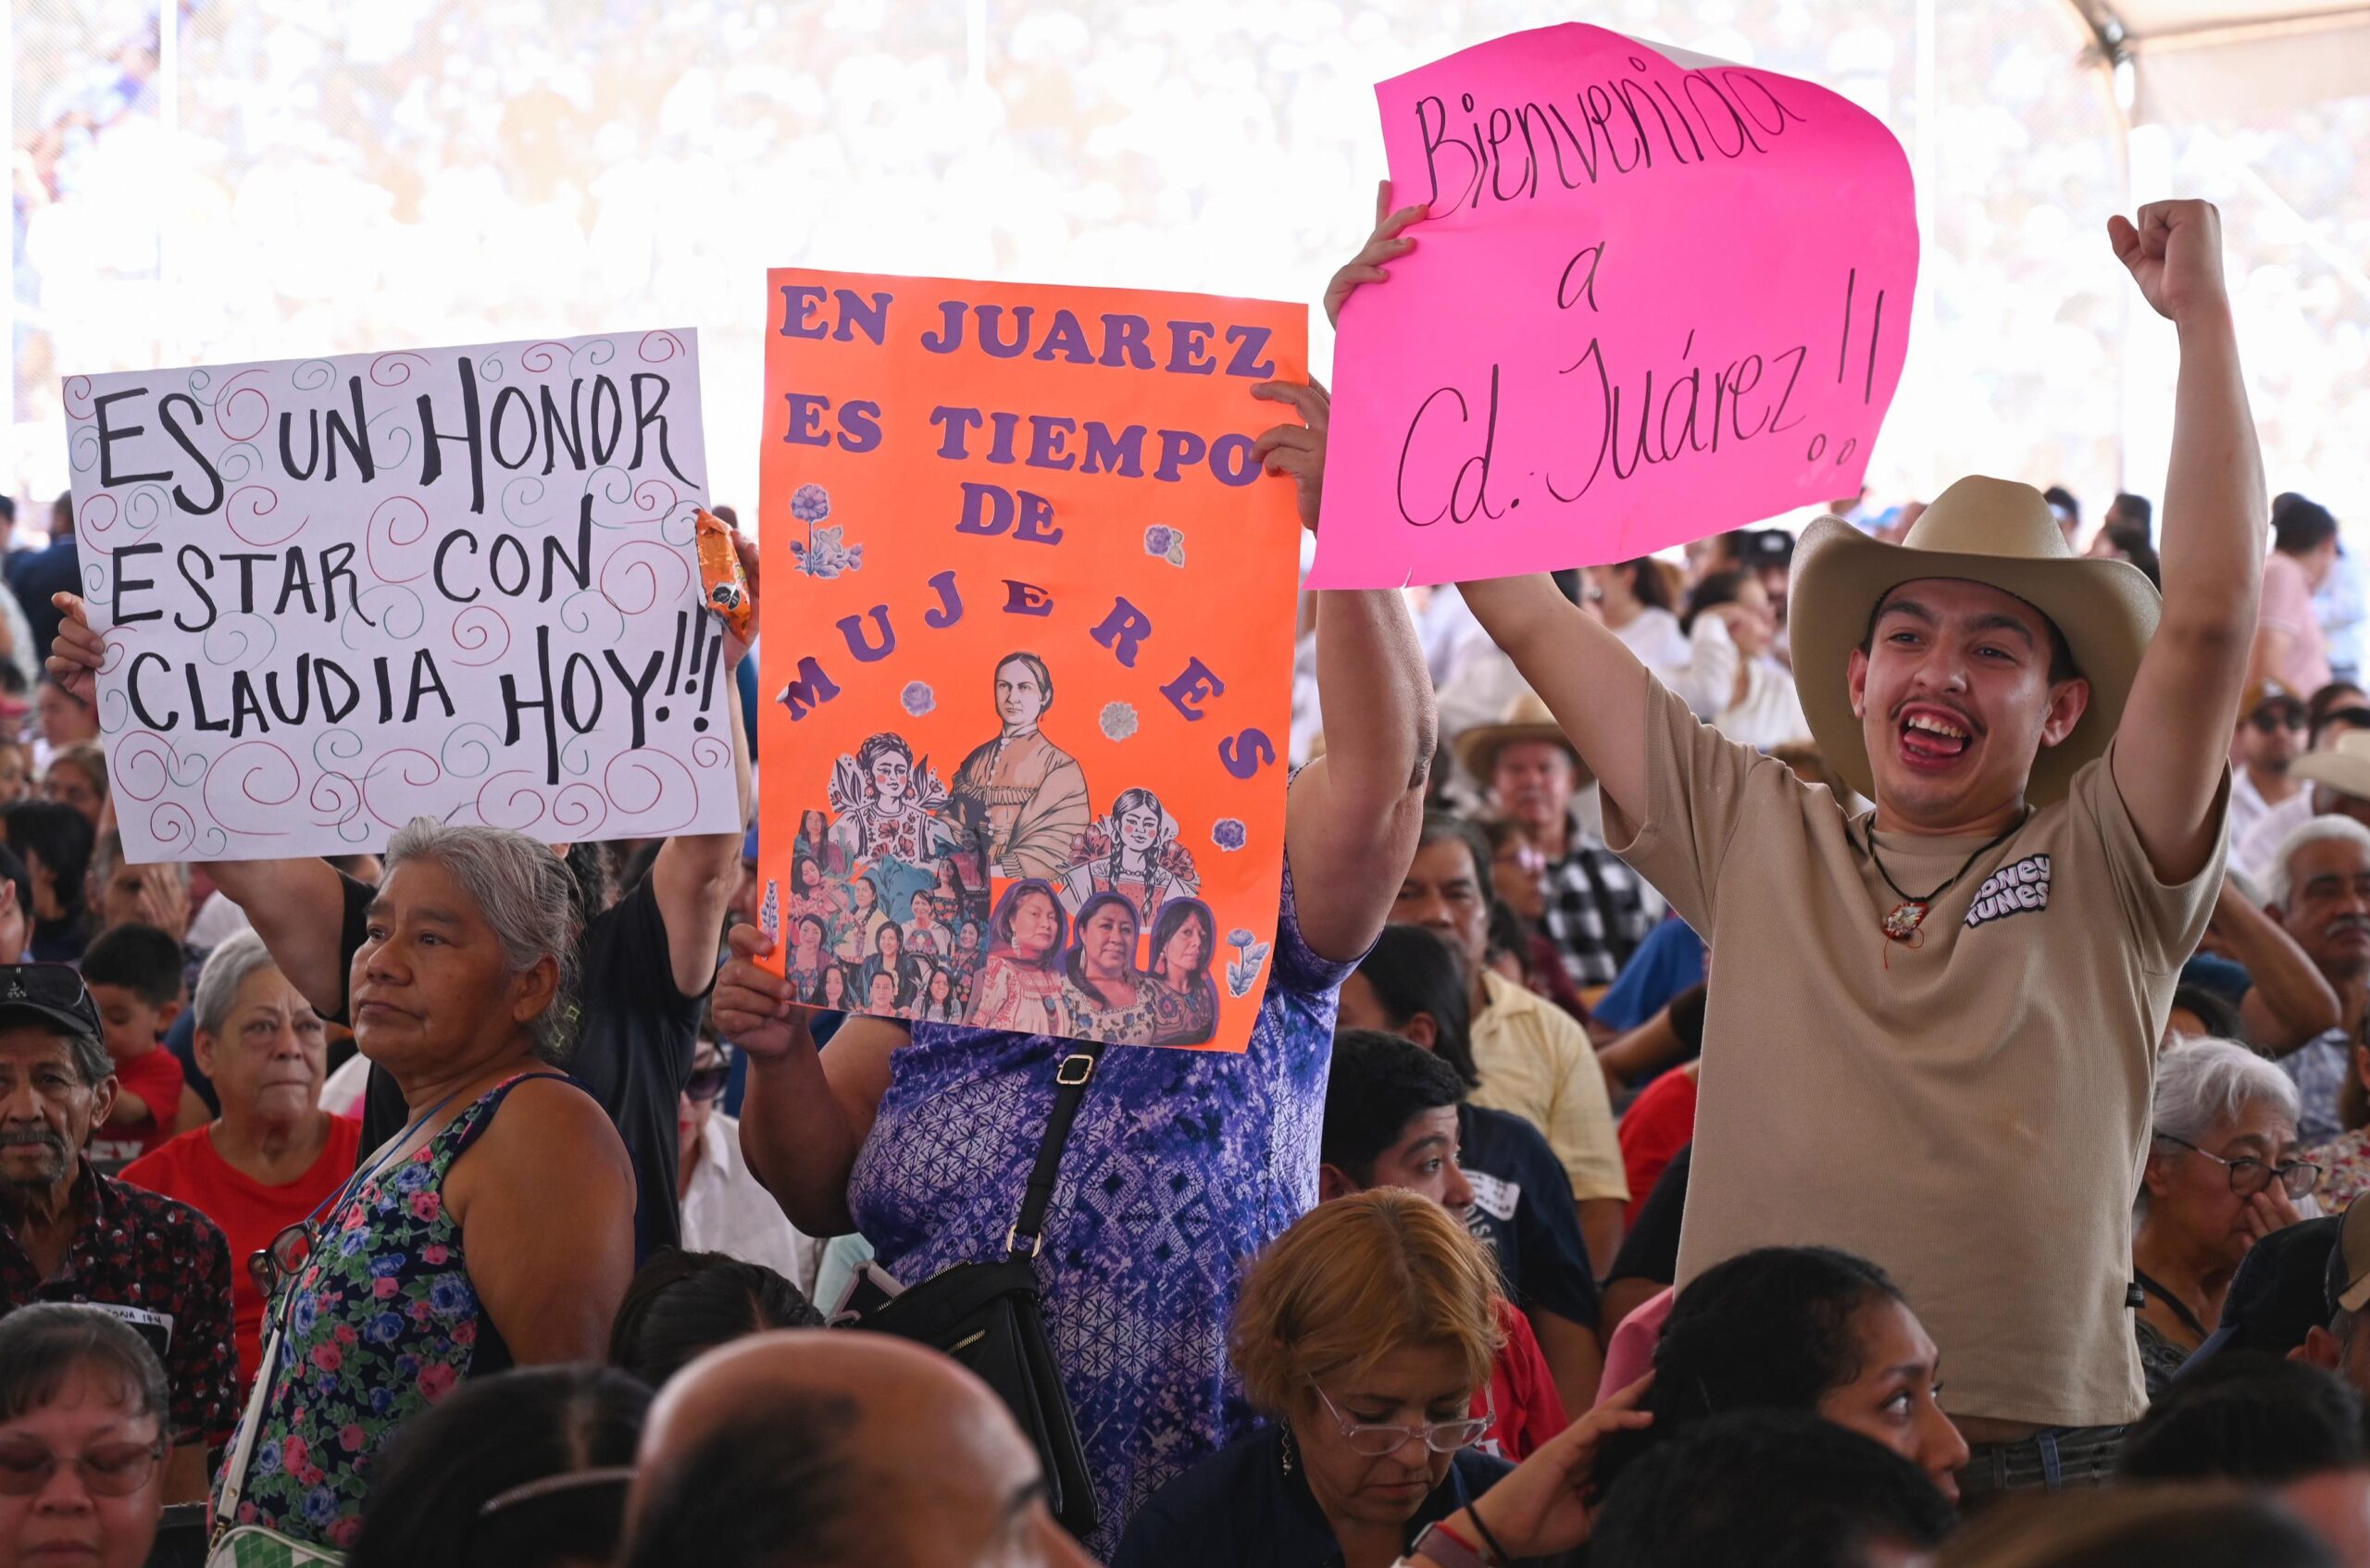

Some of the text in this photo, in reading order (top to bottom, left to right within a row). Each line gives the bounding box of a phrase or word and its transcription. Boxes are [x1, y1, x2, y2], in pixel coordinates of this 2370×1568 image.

[1415, 57, 1806, 220] Bienvenida
[780, 285, 1276, 380] EN JUAREZ
[1557, 241, 1605, 313] a
[94, 356, 701, 516] ES UN HONOR
[783, 392, 1265, 487] ES TIEMPO
[1397, 363, 1520, 527] Cd.
[112, 492, 594, 633] ESTAR CON
[954, 481, 1064, 546] DE
[127, 599, 723, 786] CLAUDIA HOY!!!
[777, 570, 1277, 779] MUJERES
